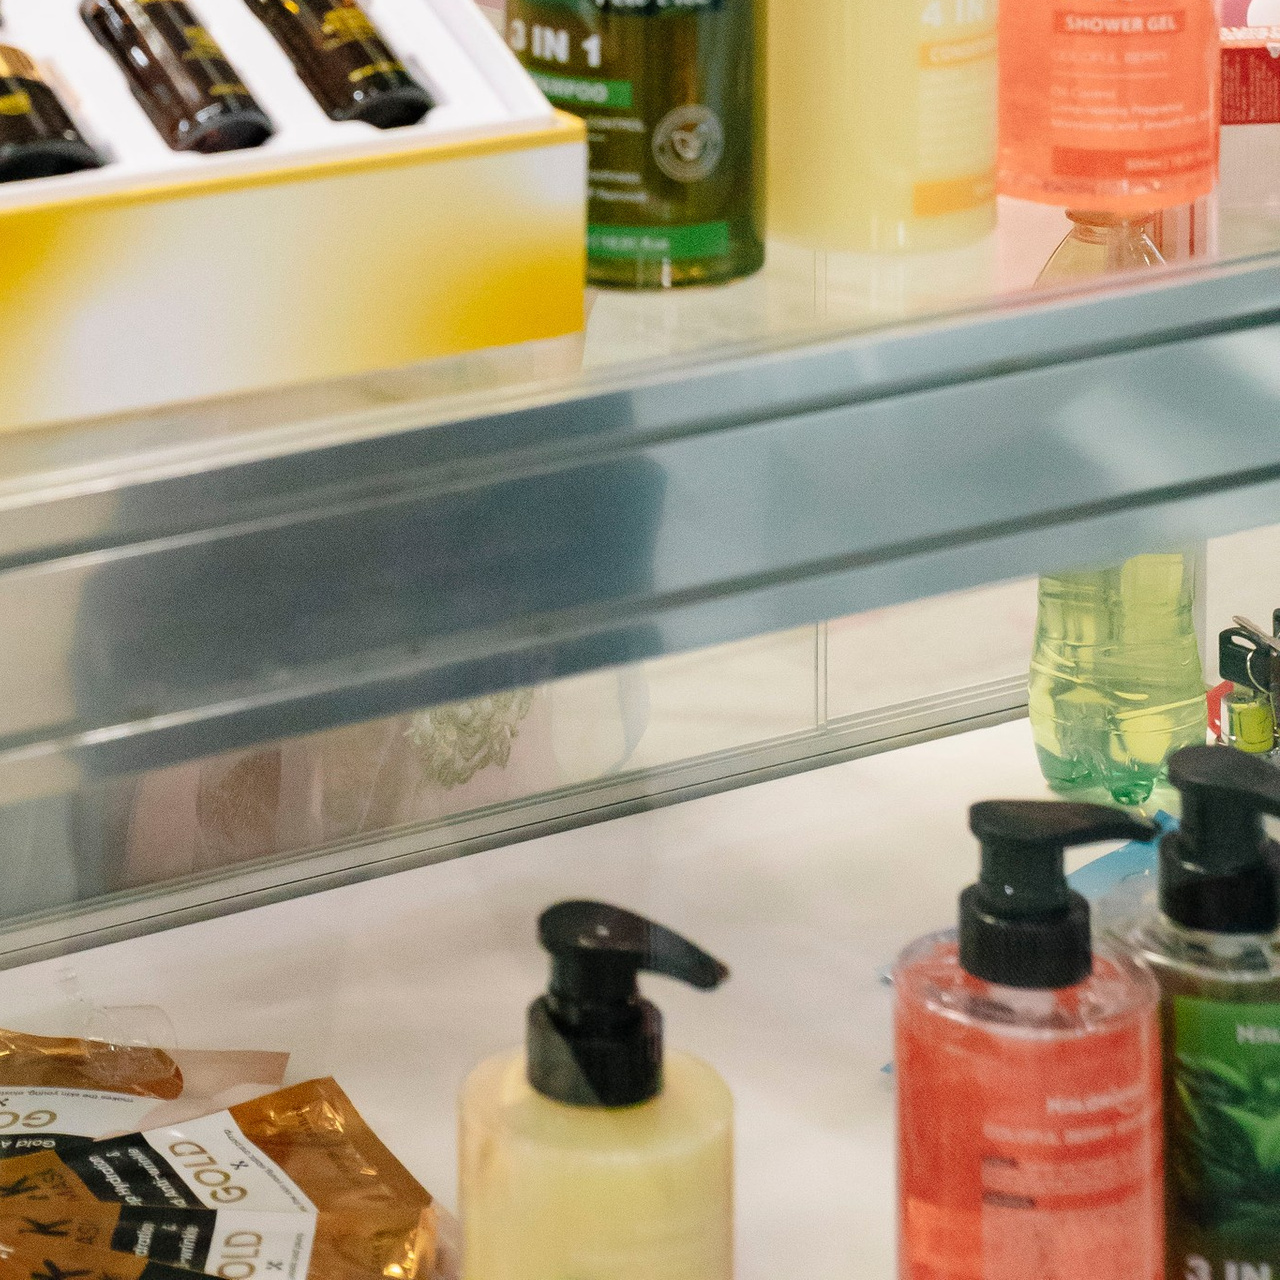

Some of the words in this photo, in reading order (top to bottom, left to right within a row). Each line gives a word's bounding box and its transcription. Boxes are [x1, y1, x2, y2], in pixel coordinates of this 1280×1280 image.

[921, 0, 942, 28] 4
[1065, 16, 1144, 33] SHOWER
[1147, 15, 1177, 32] GEL
[531, 24, 570, 63] IN
[581, 33, 601, 68] 1
[15, 1139, 56, 1149] Gold
[168, 1141, 248, 1204] GOLD
